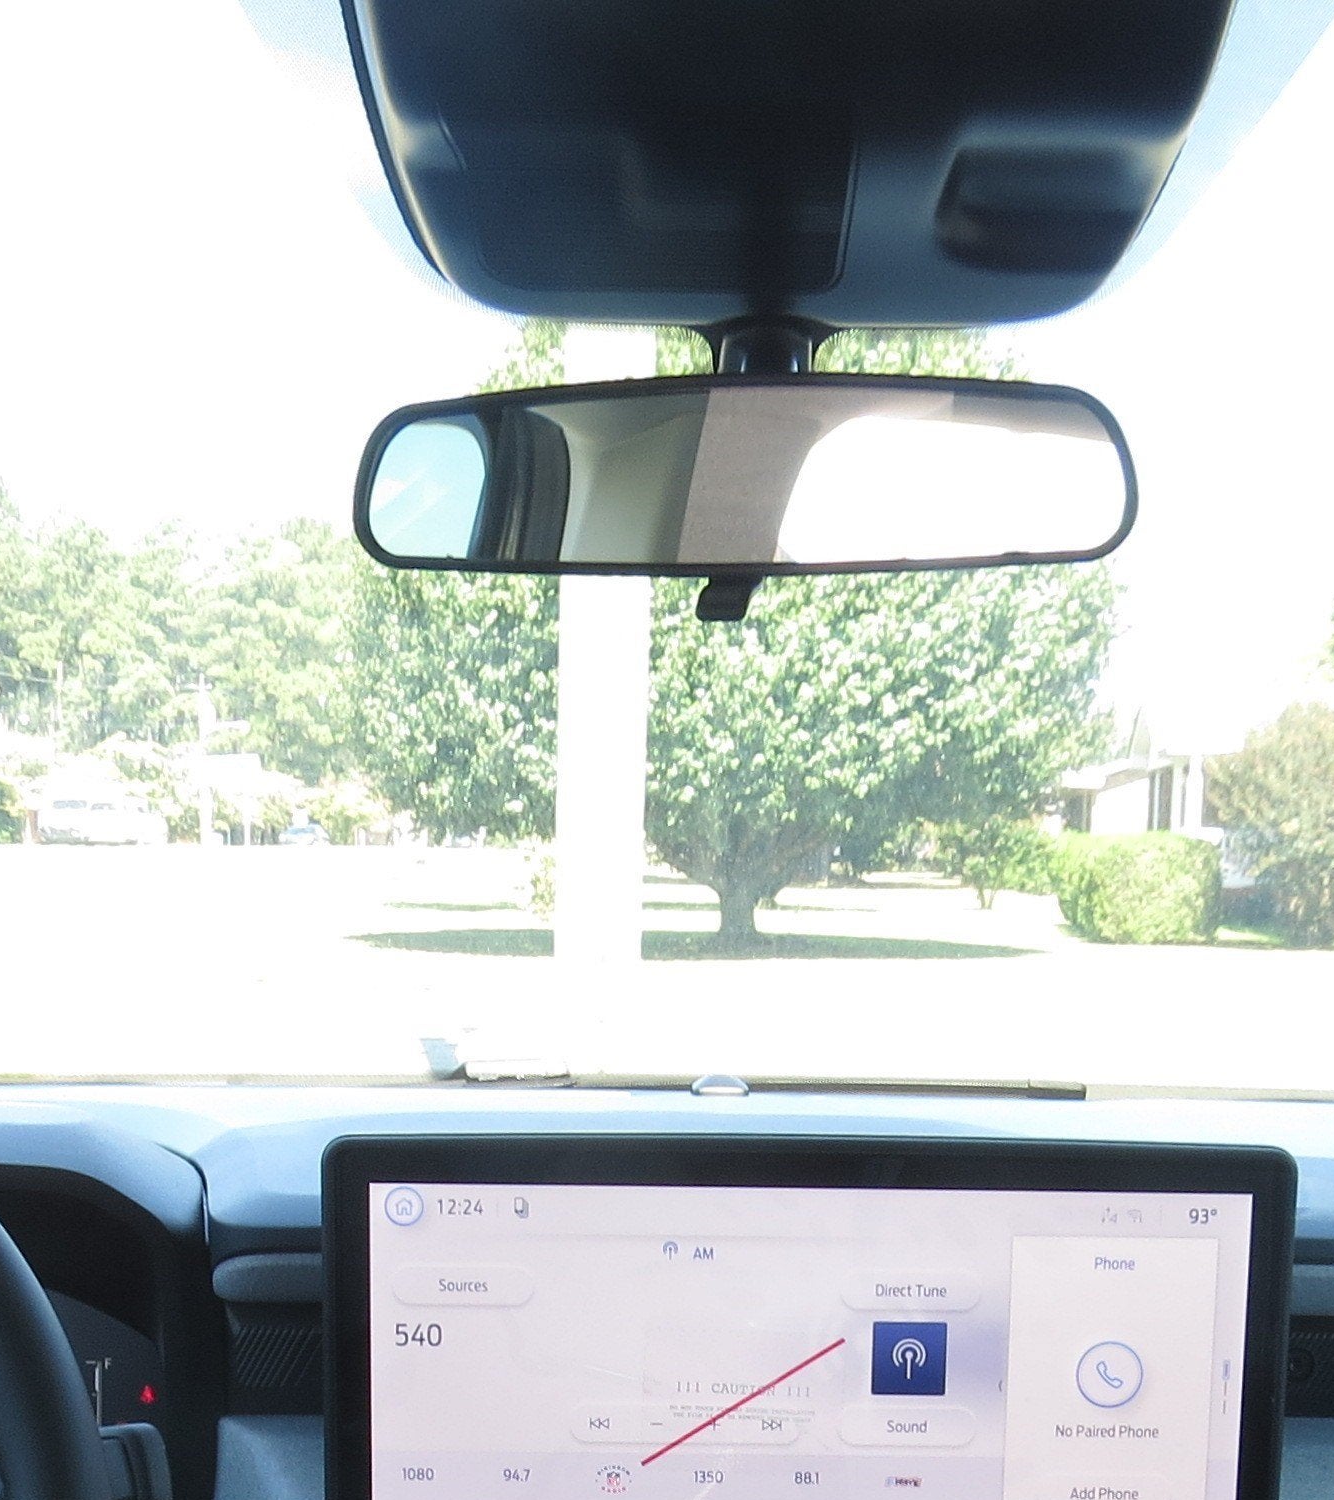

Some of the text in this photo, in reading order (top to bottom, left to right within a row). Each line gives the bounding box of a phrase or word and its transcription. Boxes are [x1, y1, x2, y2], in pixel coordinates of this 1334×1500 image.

[437, 1198, 484, 1215] 12:24
[1188, 1208, 1218, 1224] 93°
[692, 1246, 715, 1261] AM
[1093, 1256, 1136, 1271] Phone
[438, 1278, 488, 1293] Sources
[875, 1283, 947, 1298] Direct Tune
[394, 1322, 443, 1348] 540
[711, 1382, 774, 1397] CAUTIN
[886, 1419, 928, 1434] Sound
[1055, 1424, 1159, 1439] No Paired Phone
[401, 1467, 435, 1482] 1080
[502, 1468, 531, 1482] 94.7
[693, 1470, 724, 1484] 1350
[794, 1471, 820, 1485] 88.1
[1070, 1487, 1139, 1500] Add Phone
